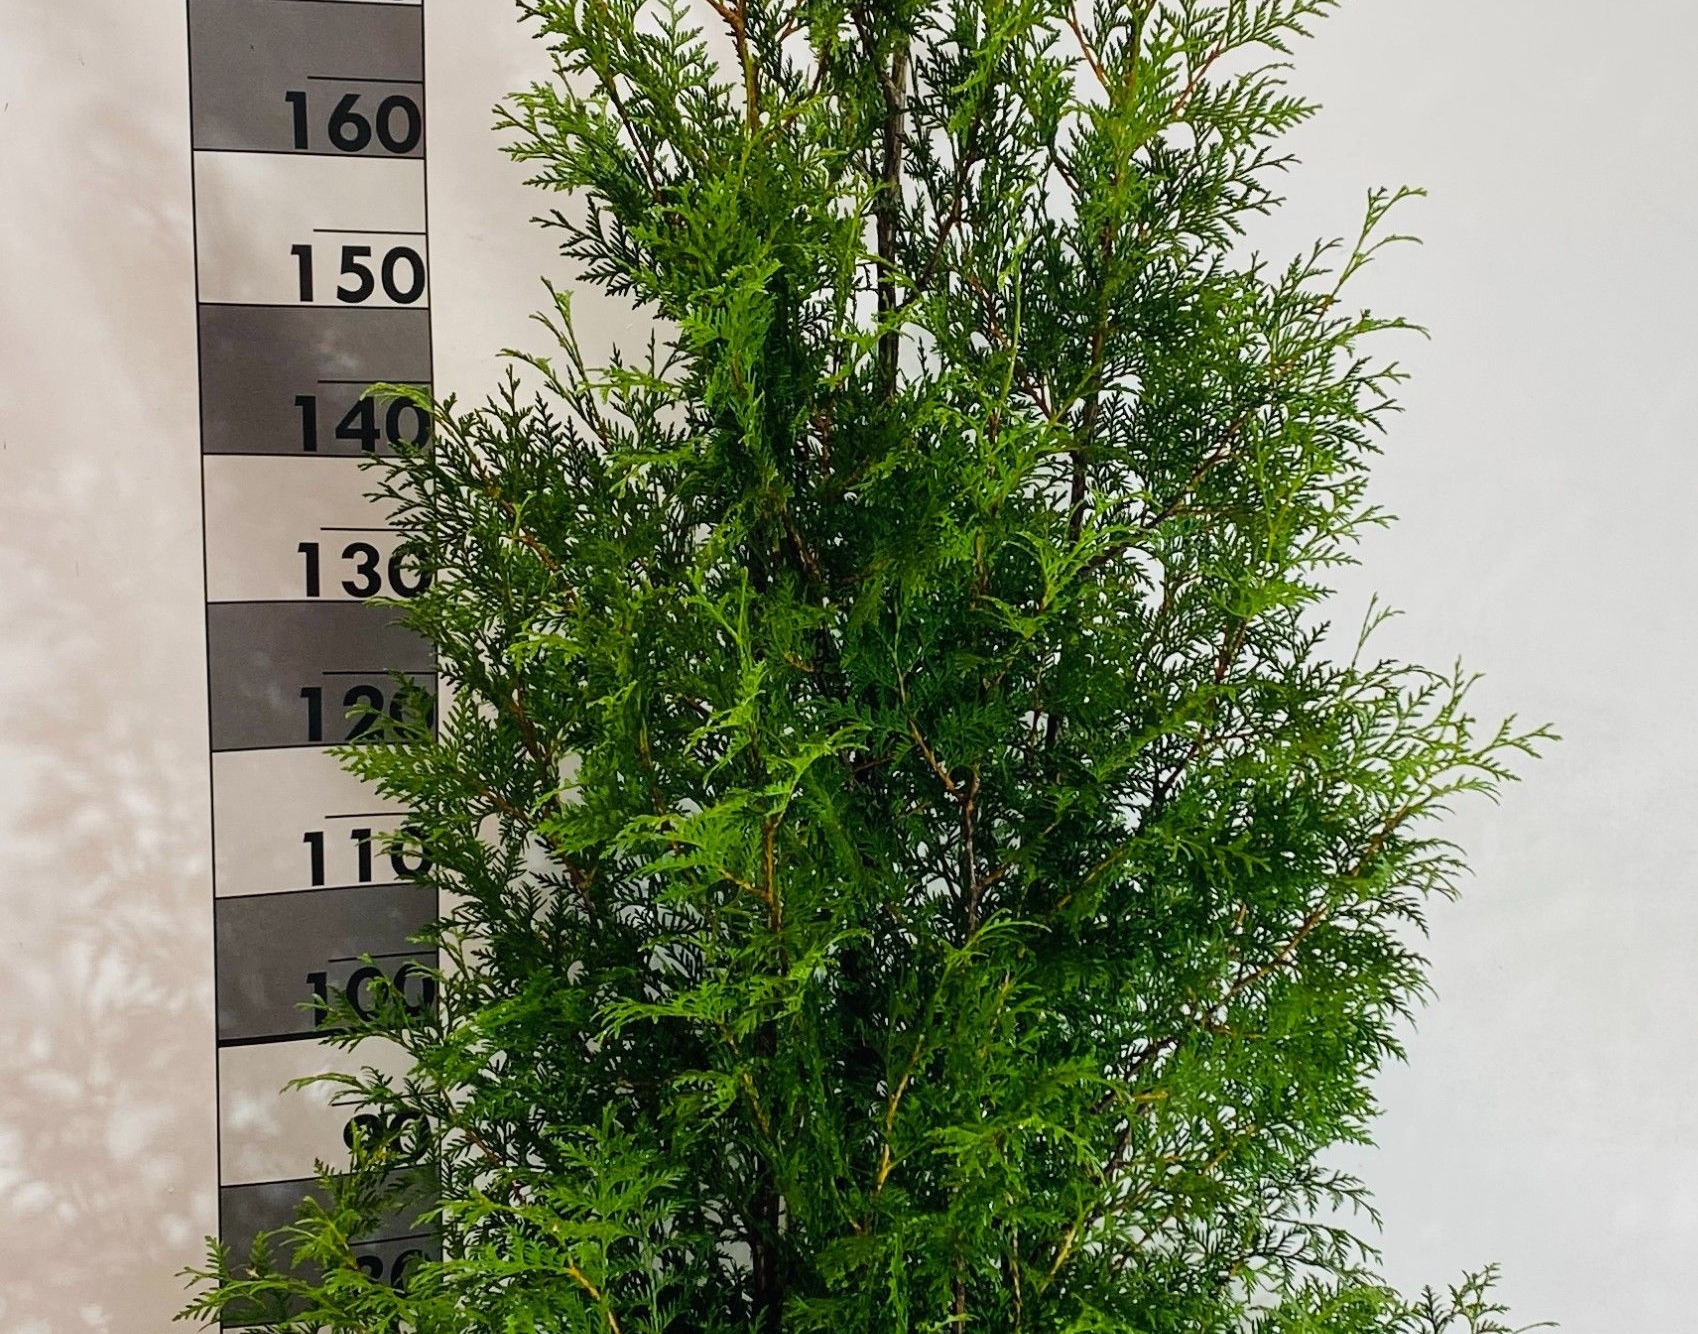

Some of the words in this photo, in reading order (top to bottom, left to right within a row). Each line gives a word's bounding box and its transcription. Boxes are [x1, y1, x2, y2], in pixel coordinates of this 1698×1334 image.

[285, 91, 422, 154] 160
[291, 244, 426, 305] 150
[294, 395, 431, 453] 140
[298, 542, 433, 598] 130
